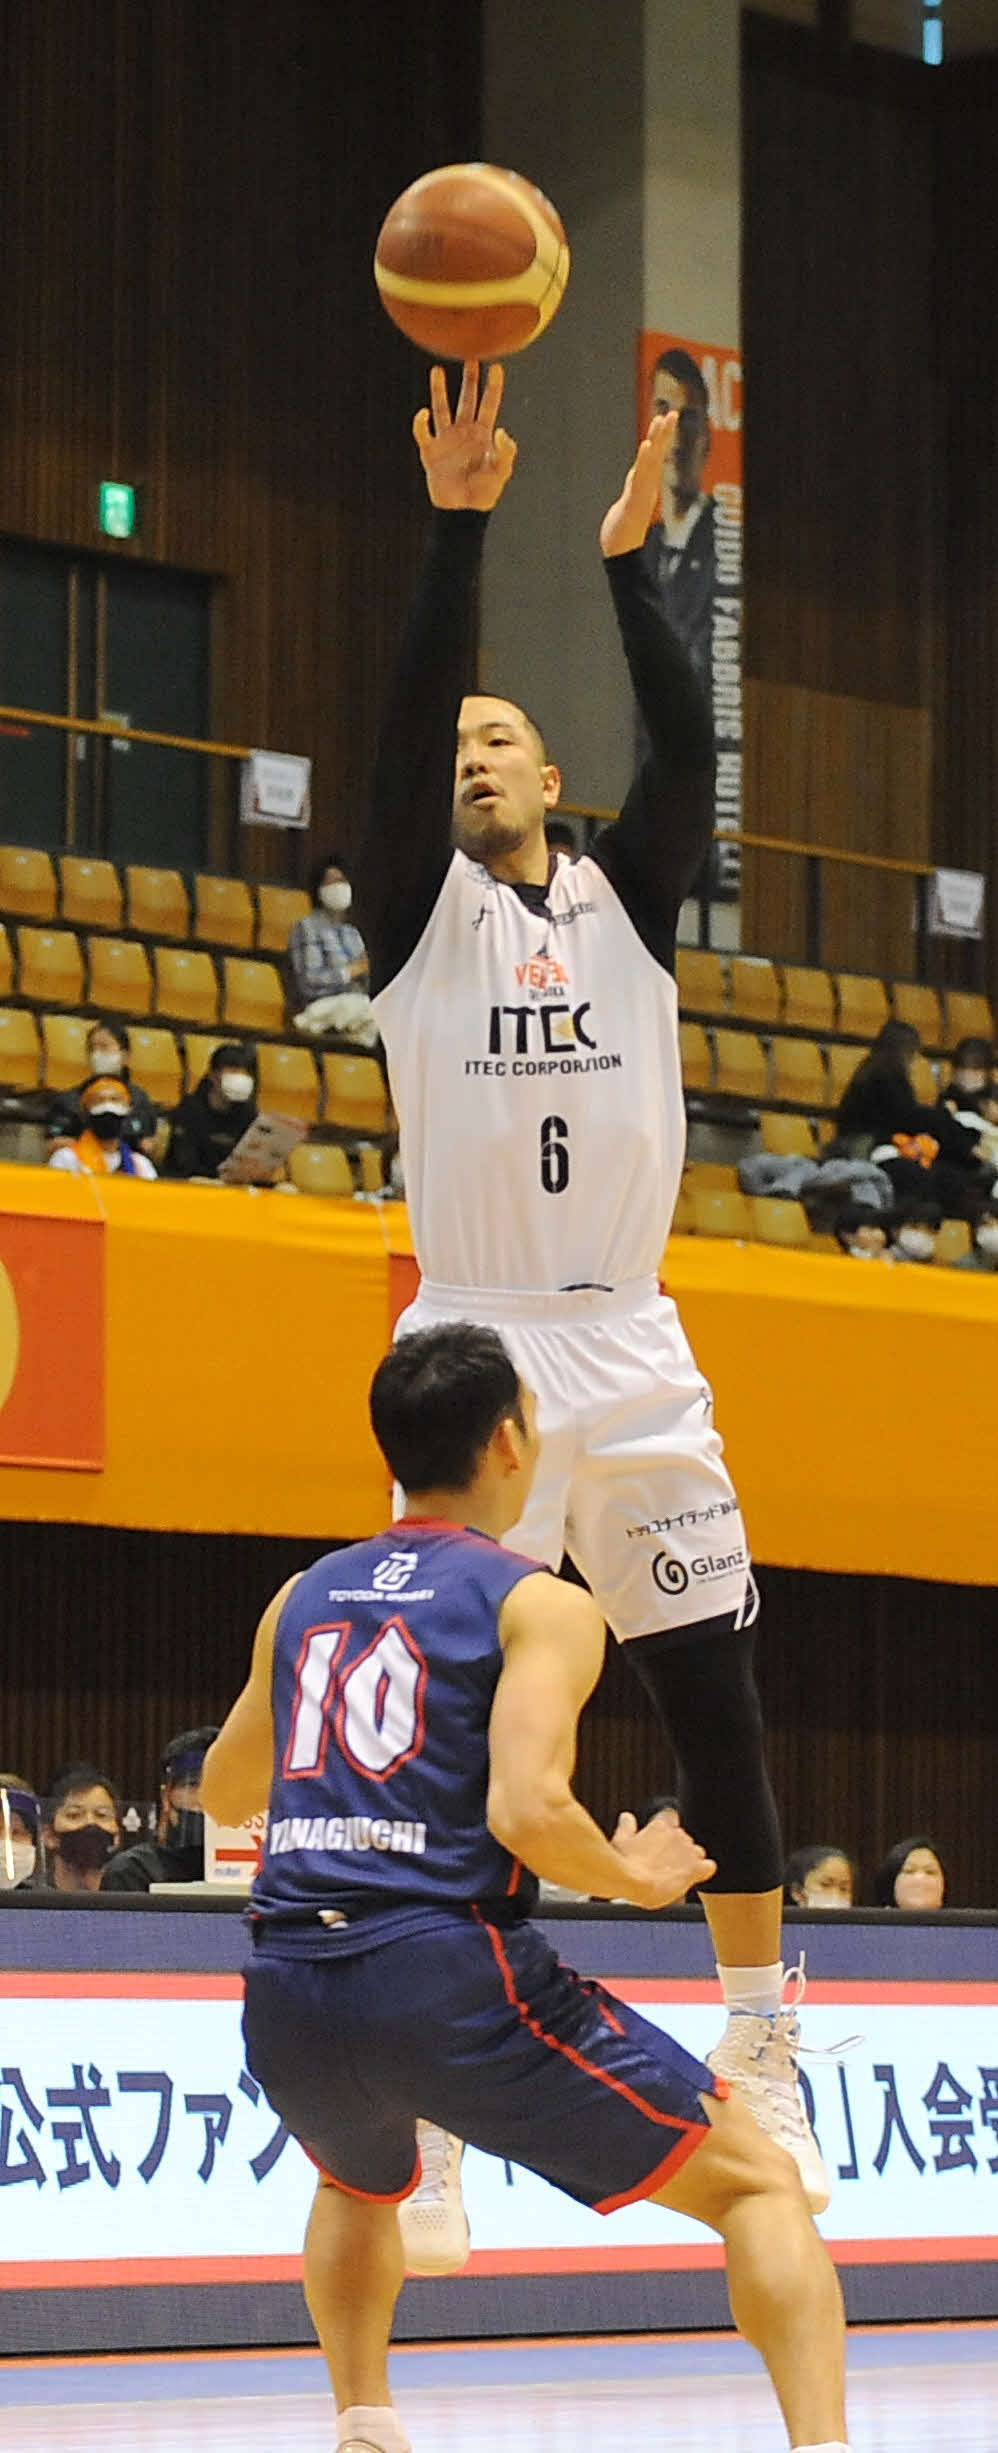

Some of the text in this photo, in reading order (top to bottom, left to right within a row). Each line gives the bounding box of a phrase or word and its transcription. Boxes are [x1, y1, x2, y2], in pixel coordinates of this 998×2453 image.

[712, 482, 743, 586] GUIDO
[488, 1002, 597, 1055] ITEC
[464, 1061, 506, 1077] ITEC
[541, 1114, 570, 1195] 6
[691, 1551, 745, 1576] Glanz
[282, 1614, 429, 1784] 10
